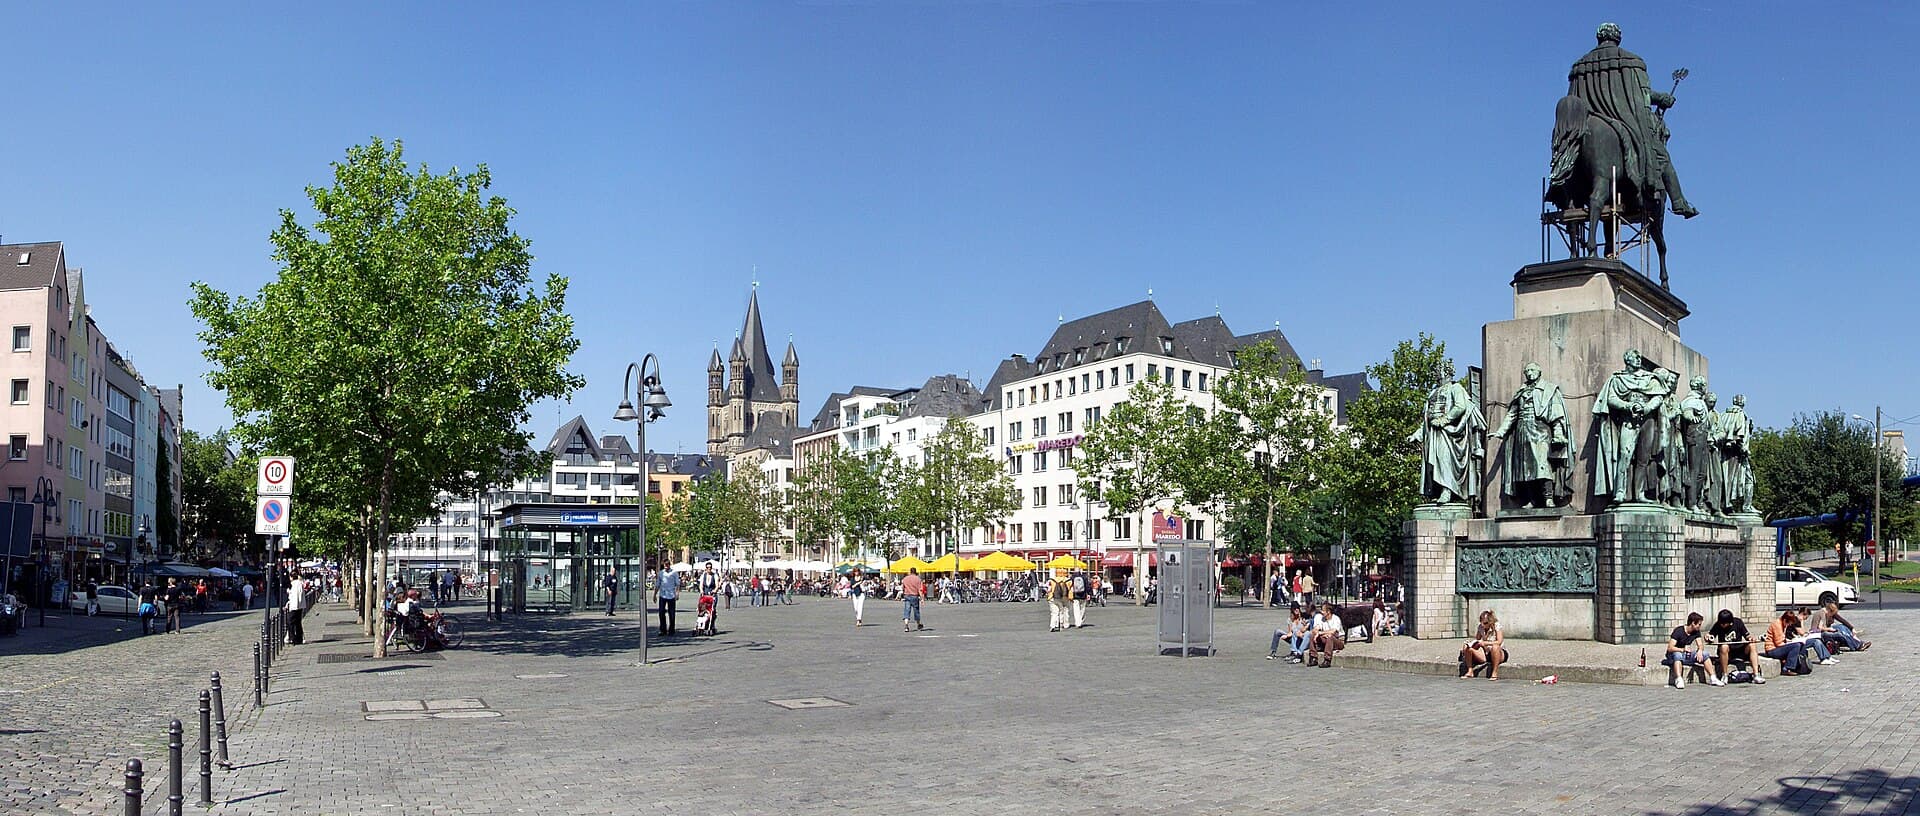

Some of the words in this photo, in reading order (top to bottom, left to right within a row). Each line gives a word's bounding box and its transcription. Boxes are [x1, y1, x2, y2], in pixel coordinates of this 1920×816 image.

[1037, 435, 1083, 452] MAREDO
[271, 466, 281, 478] 10
[264, 524, 281, 532] ZONE
